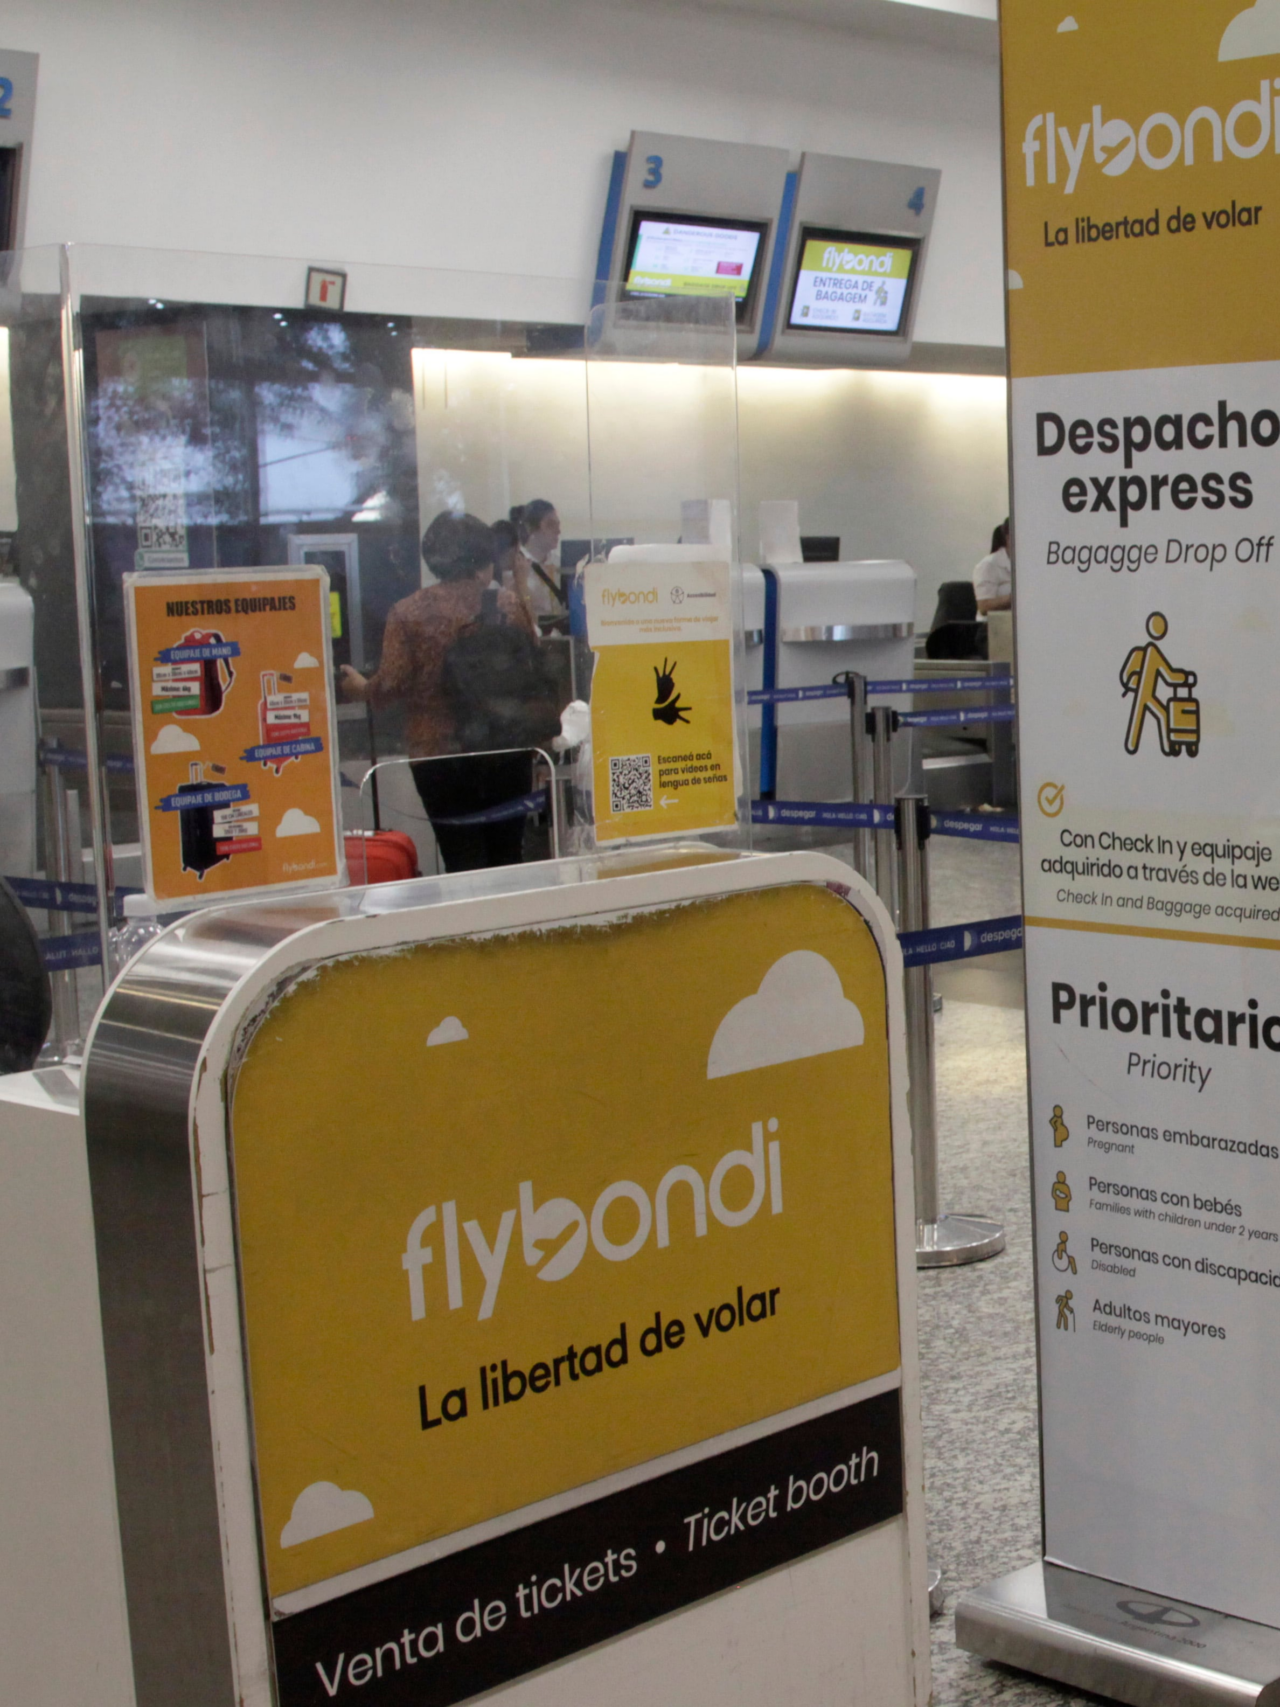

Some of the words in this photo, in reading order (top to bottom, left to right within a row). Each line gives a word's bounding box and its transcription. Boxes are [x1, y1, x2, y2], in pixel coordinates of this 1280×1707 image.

[0, 76, 13, 118] 2
[643, 155, 663, 188] 3
[907, 186, 926, 216] 4
[1044, 221, 1068, 247] La
[1075, 208, 1159, 243] libertad
[1167, 206, 1196, 234] de
[1202, 199, 1262, 229] volar
[822, 246, 894, 273] flybondi
[813, 276, 859, 292] ENTREGA
[861, 280, 875, 292] DE
[815, 289, 868, 304] BAGAGEM
[1036, 400, 1280, 469] Despacho
[1061, 471, 1254, 528] express
[1046, 540, 1158, 573] Bagagge
[1165, 538, 1227, 572] Drop
[1235, 535, 1275, 563] Off
[166, 599, 232, 617] NUESTROS
[234, 596, 296, 614] EQUIPAJES
[601, 586, 658, 608] flybondi
[170, 648, 201, 660] EQUIPAJE
[202, 647, 211, 657] DE
[212, 646, 232, 657] MANO
[254, 746, 282, 758] EQUIPAJE
[283, 745, 291, 754] DE
[292, 742, 315, 753] CABINA
[658, 751, 694, 765] Escaneá
[696, 750, 712, 760] acá
[659, 767, 679, 779] para
[710, 763, 721, 771] en
[659, 778, 690, 790] lengua
[691, 776, 702, 785] de
[703, 774, 728, 784] señas
[171, 794, 202, 807] EQUIPAJE
[204, 793, 213, 803] DE
[214, 789, 242, 802] BODEGA
[781, 808, 816, 819] despegar
[944, 819, 983, 832] despegar
[1060, 829, 1095, 849] Con
[1098, 831, 1154, 854] Check
[1157, 836, 1173, 855] In
[1176, 840, 1188, 862] y
[1191, 839, 1272, 868] equipaje
[1041, 856, 1123, 881] adquirido
[1126, 864, 1139, 880] a
[1142, 862, 1199, 885] través
[1202, 866, 1227, 887] de
[1231, 868, 1248, 890] la
[1056, 889, 1098, 906] Check
[1101, 892, 1113, 907] In
[1116, 894, 1143, 910] and
[1146, 897, 1211, 919] Baggage
[1214, 905, 1280, 923] acquired
[916, 943, 937, 954] HELLO
[940, 940, 956, 950] CIAO
[980, 927, 1022, 944] despega
[1127, 1052, 1212, 1093] Priority
[1087, 1114, 1159, 1141] Personas
[1162, 1128, 1280, 1160] embarazadas
[1087, 1137, 1135, 1155] Pregnant
[1088, 1176, 1158, 1202] Personas
[1160, 1191, 1191, 1209] con
[1193, 1193, 1243, 1218] bebés
[401, 1116, 783, 1322] flybondi
[1089, 1198, 1132, 1216] Families
[1133, 1206, 1156, 1220] with
[1158, 1210, 1201, 1229] children
[1203, 1219, 1237, 1235] under
[1238, 1225, 1246, 1237] 2
[1247, 1228, 1279, 1243] years
[1090, 1237, 1159, 1264] Personas
[1162, 1253, 1192, 1271] con
[1091, 1259, 1137, 1278] Disabled
[1092, 1299, 1151, 1325] Adultos
[1154, 1312, 1227, 1340] mayores
[1093, 1320, 1125, 1339] Elderly
[1127, 1327, 1165, 1346] people
[418, 1384, 468, 1432] La
[479, 1322, 629, 1411] libertad
[639, 1311, 686, 1358] de
[694, 1285, 781, 1339] volar
[315, 1619, 445, 1698] Venta
[454, 1598, 508, 1645] de
[514, 1543, 639, 1620] tickets
[682, 1484, 780, 1554] Ticket
[786, 1446, 879, 1513] booth
